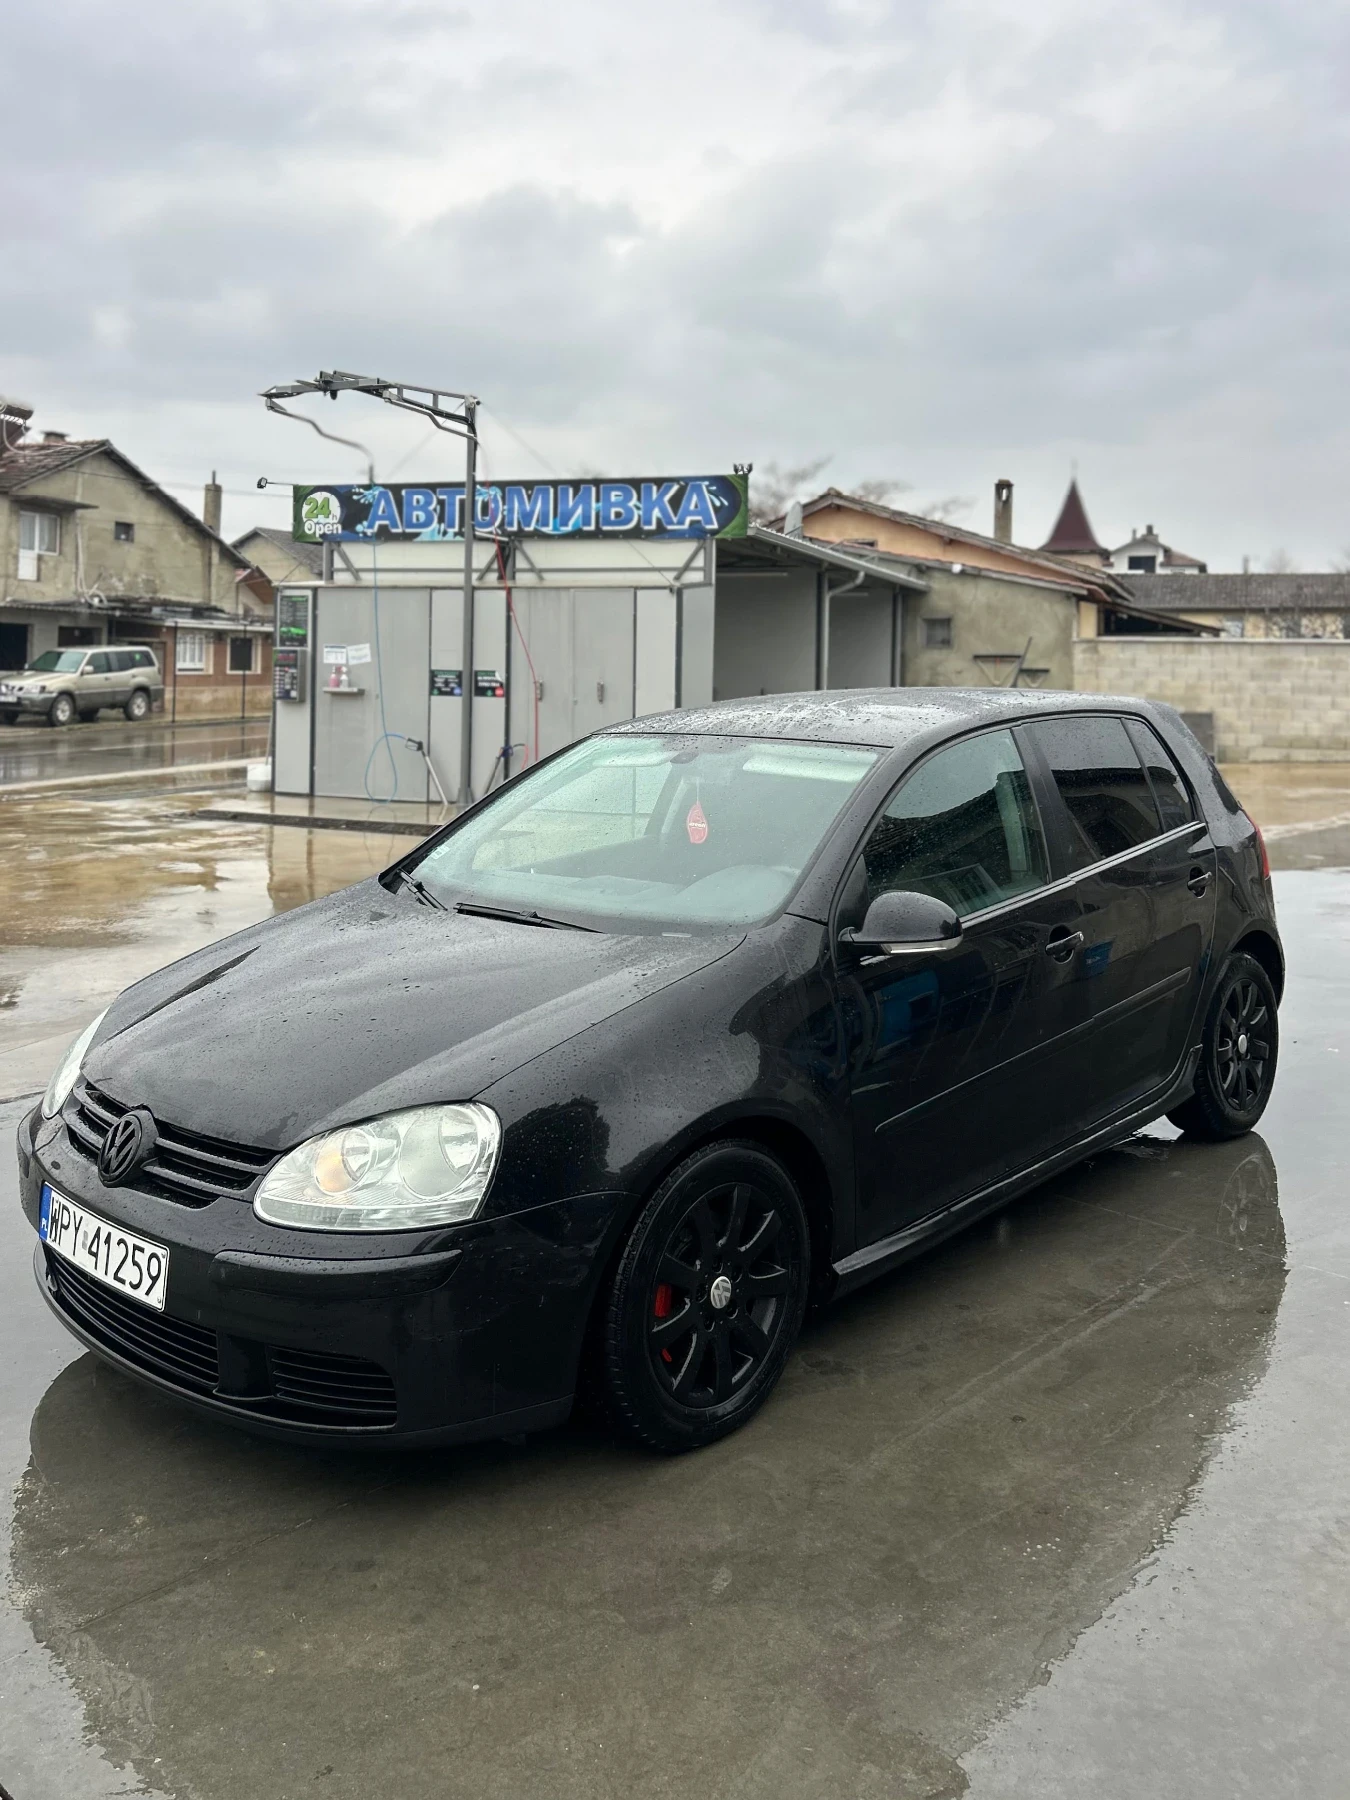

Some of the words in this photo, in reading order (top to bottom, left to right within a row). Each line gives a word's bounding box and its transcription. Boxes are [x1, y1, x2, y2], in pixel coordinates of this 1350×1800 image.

[366, 481, 718, 533] АВТОМИВКА
[304, 520, 342, 537] Open
[41, 1217, 48, 1232] PL
[49, 1197, 83, 1257] WPY
[87, 1225, 162, 1296] 41259
